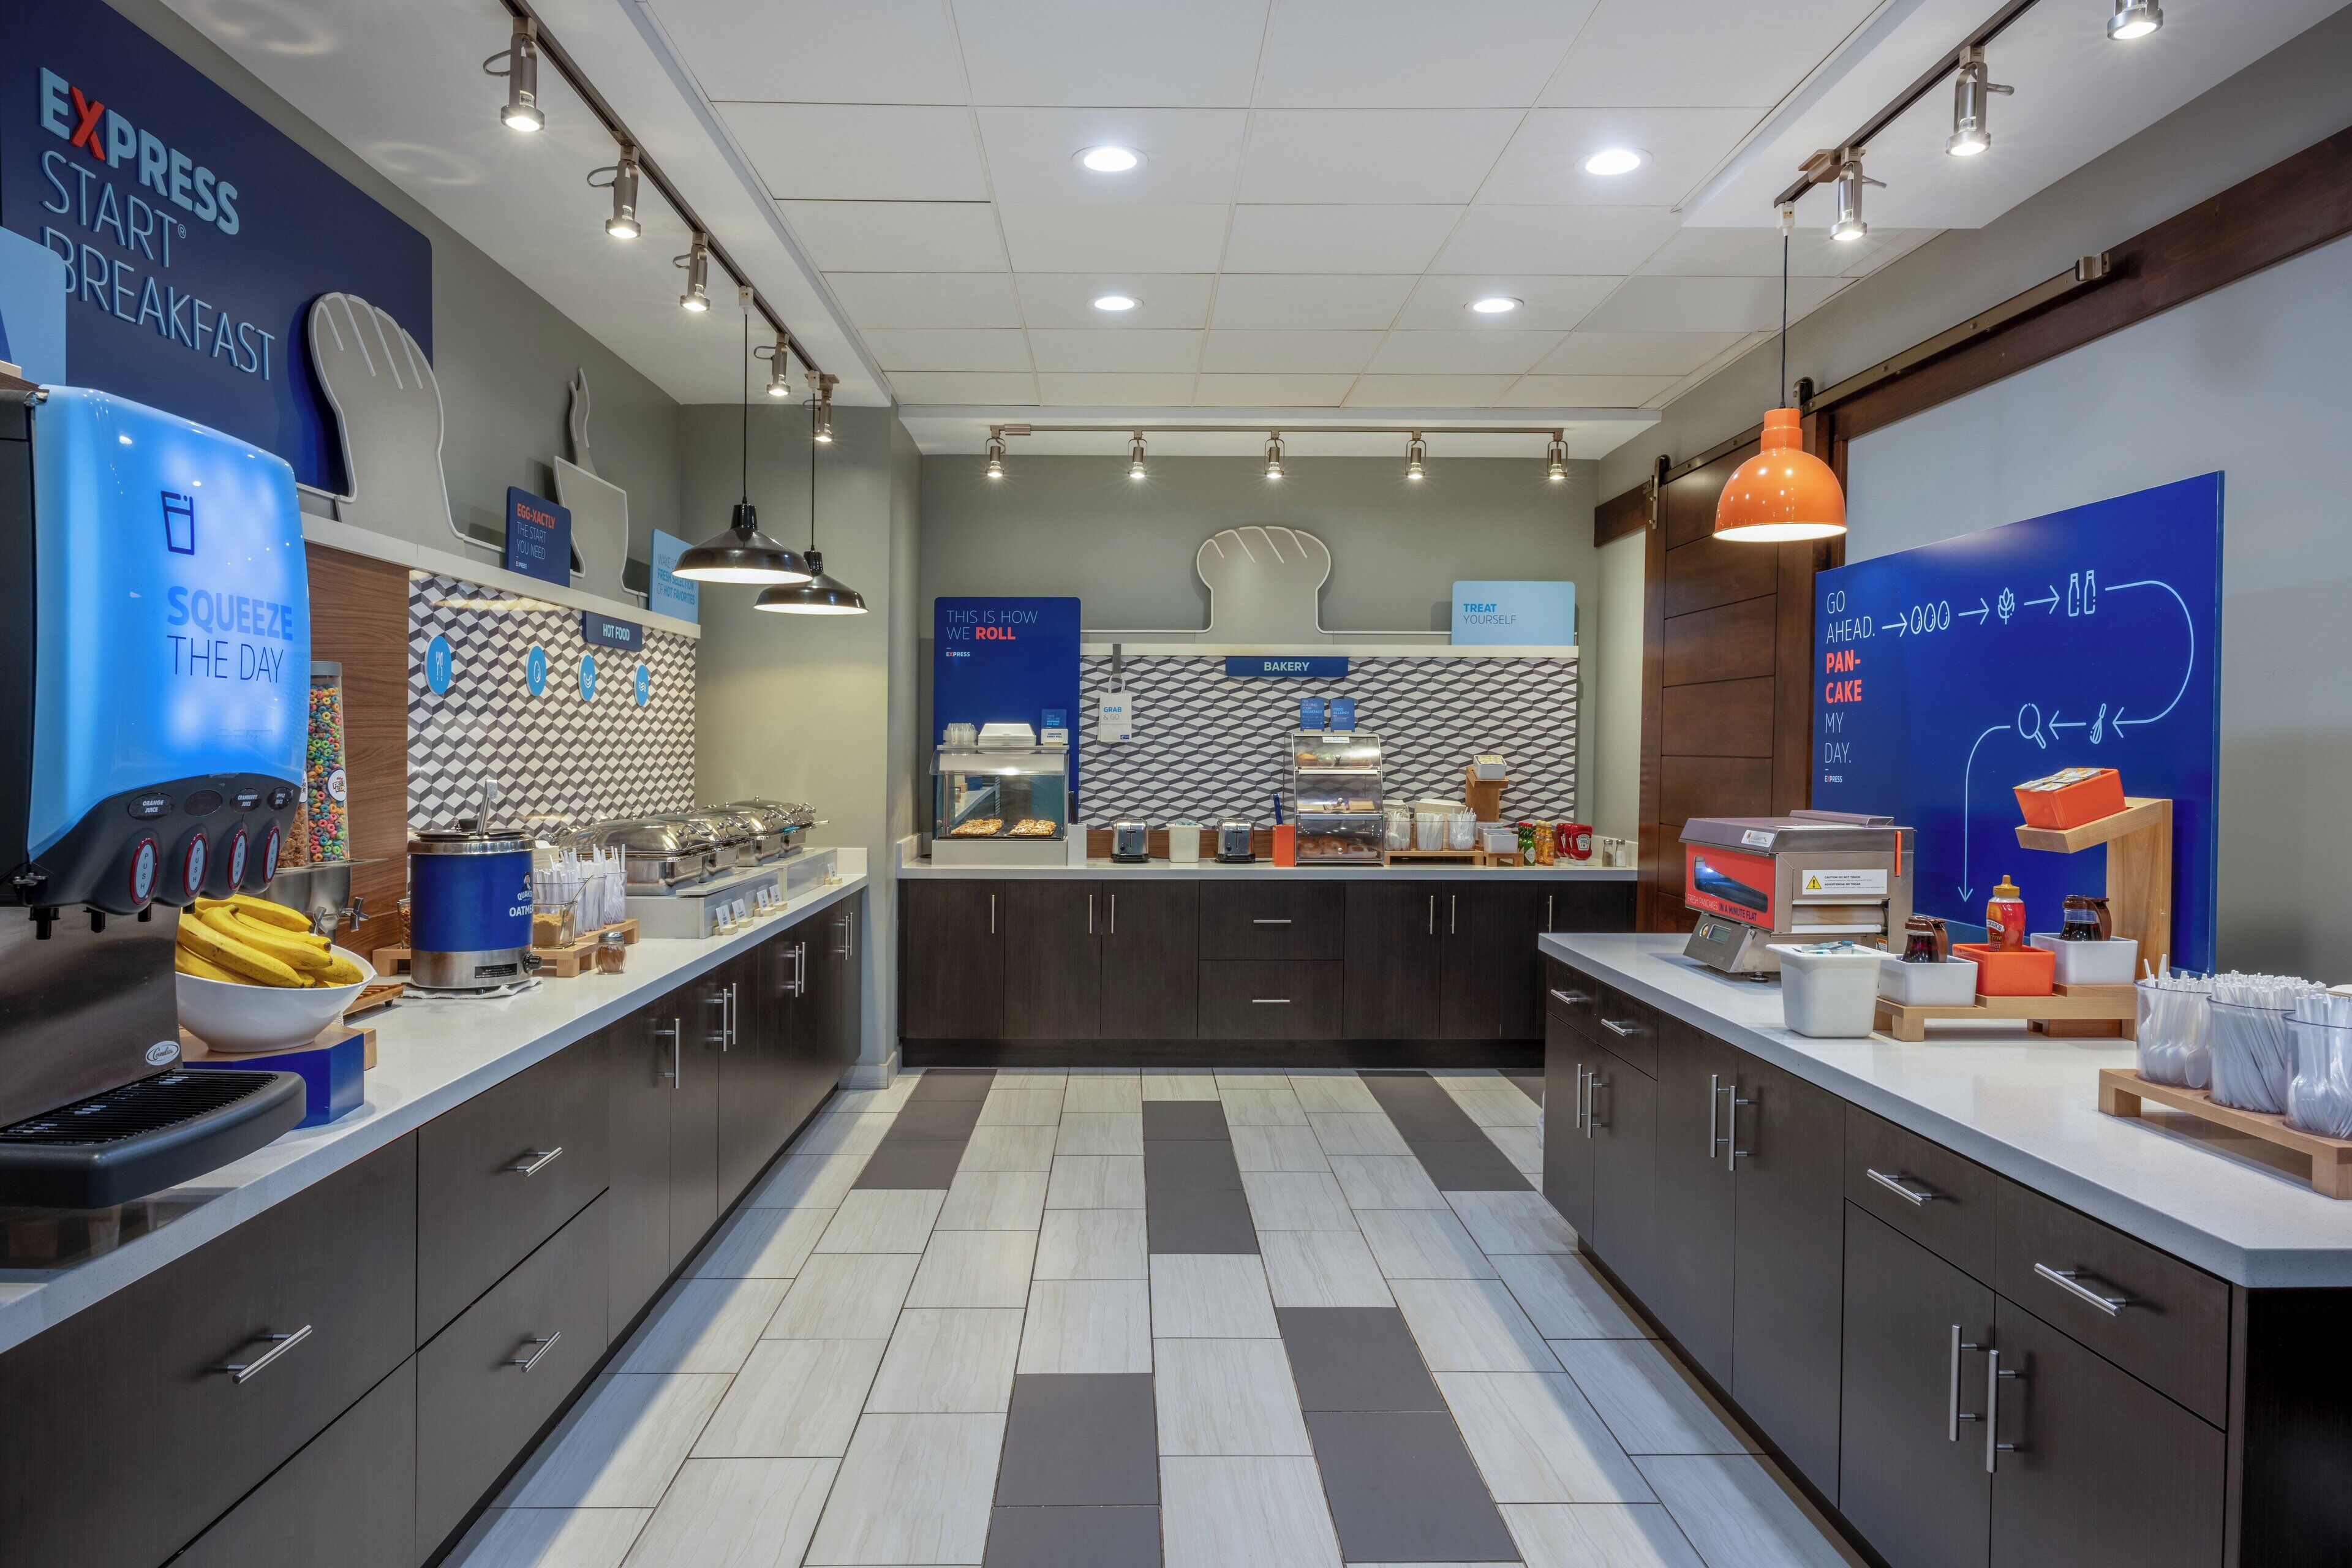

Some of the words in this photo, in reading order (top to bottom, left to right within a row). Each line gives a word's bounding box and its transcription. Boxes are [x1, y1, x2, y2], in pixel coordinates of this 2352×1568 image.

[40, 67, 239, 235] EXPRESS
[43, 226, 275, 380] BREAKFAST
[517, 503, 556, 529] EGG-XACTLY
[516, 521, 528, 537] THE
[530, 526, 546, 543] START
[516, 539, 529, 554] YOU
[530, 544, 545, 560] NEED
[516, 560, 527, 569] EXPRESS
[658, 554, 670, 568] WAKE
[658, 568, 671, 582] FRESH
[672, 575, 694, 590] SELECTION
[657, 582, 663, 594] OF
[664, 585, 673, 598] HOT
[674, 587, 695, 605] FAVORITES
[1827, 590, 1845, 614] GO
[167, 586, 293, 642] SQUEEZE
[946, 610, 978, 624] THIS
[983, 610, 995, 624] IS
[1001, 610, 1038, 624] HOW
[1463, 603, 1497, 612] TREAT
[1463, 614, 1517, 624] YOURSELF
[1826, 616, 1875, 644] AHEAD.
[602, 623, 614, 638] HOT
[615, 626, 630, 641] FOOD
[946, 627, 970, 640] WE
[976, 627, 1016, 640] ROLL
[167, 635, 228, 679] THE
[240, 643, 284, 683] DAY
[1264, 662, 1310, 671] BAKERY
[1826, 649, 1861, 674] PAN-
[1825, 679, 1862, 704] CAKE
[1825, 712, 1844, 733] MY
[1825, 742, 1852, 763] DAY.
[1687, 894, 1699, 904] FRESH
[1699, 897, 1718, 910] PANCAKES
[1729, 907, 1745, 918] MINUTE
[1746, 911, 1757, 921] FLAT
